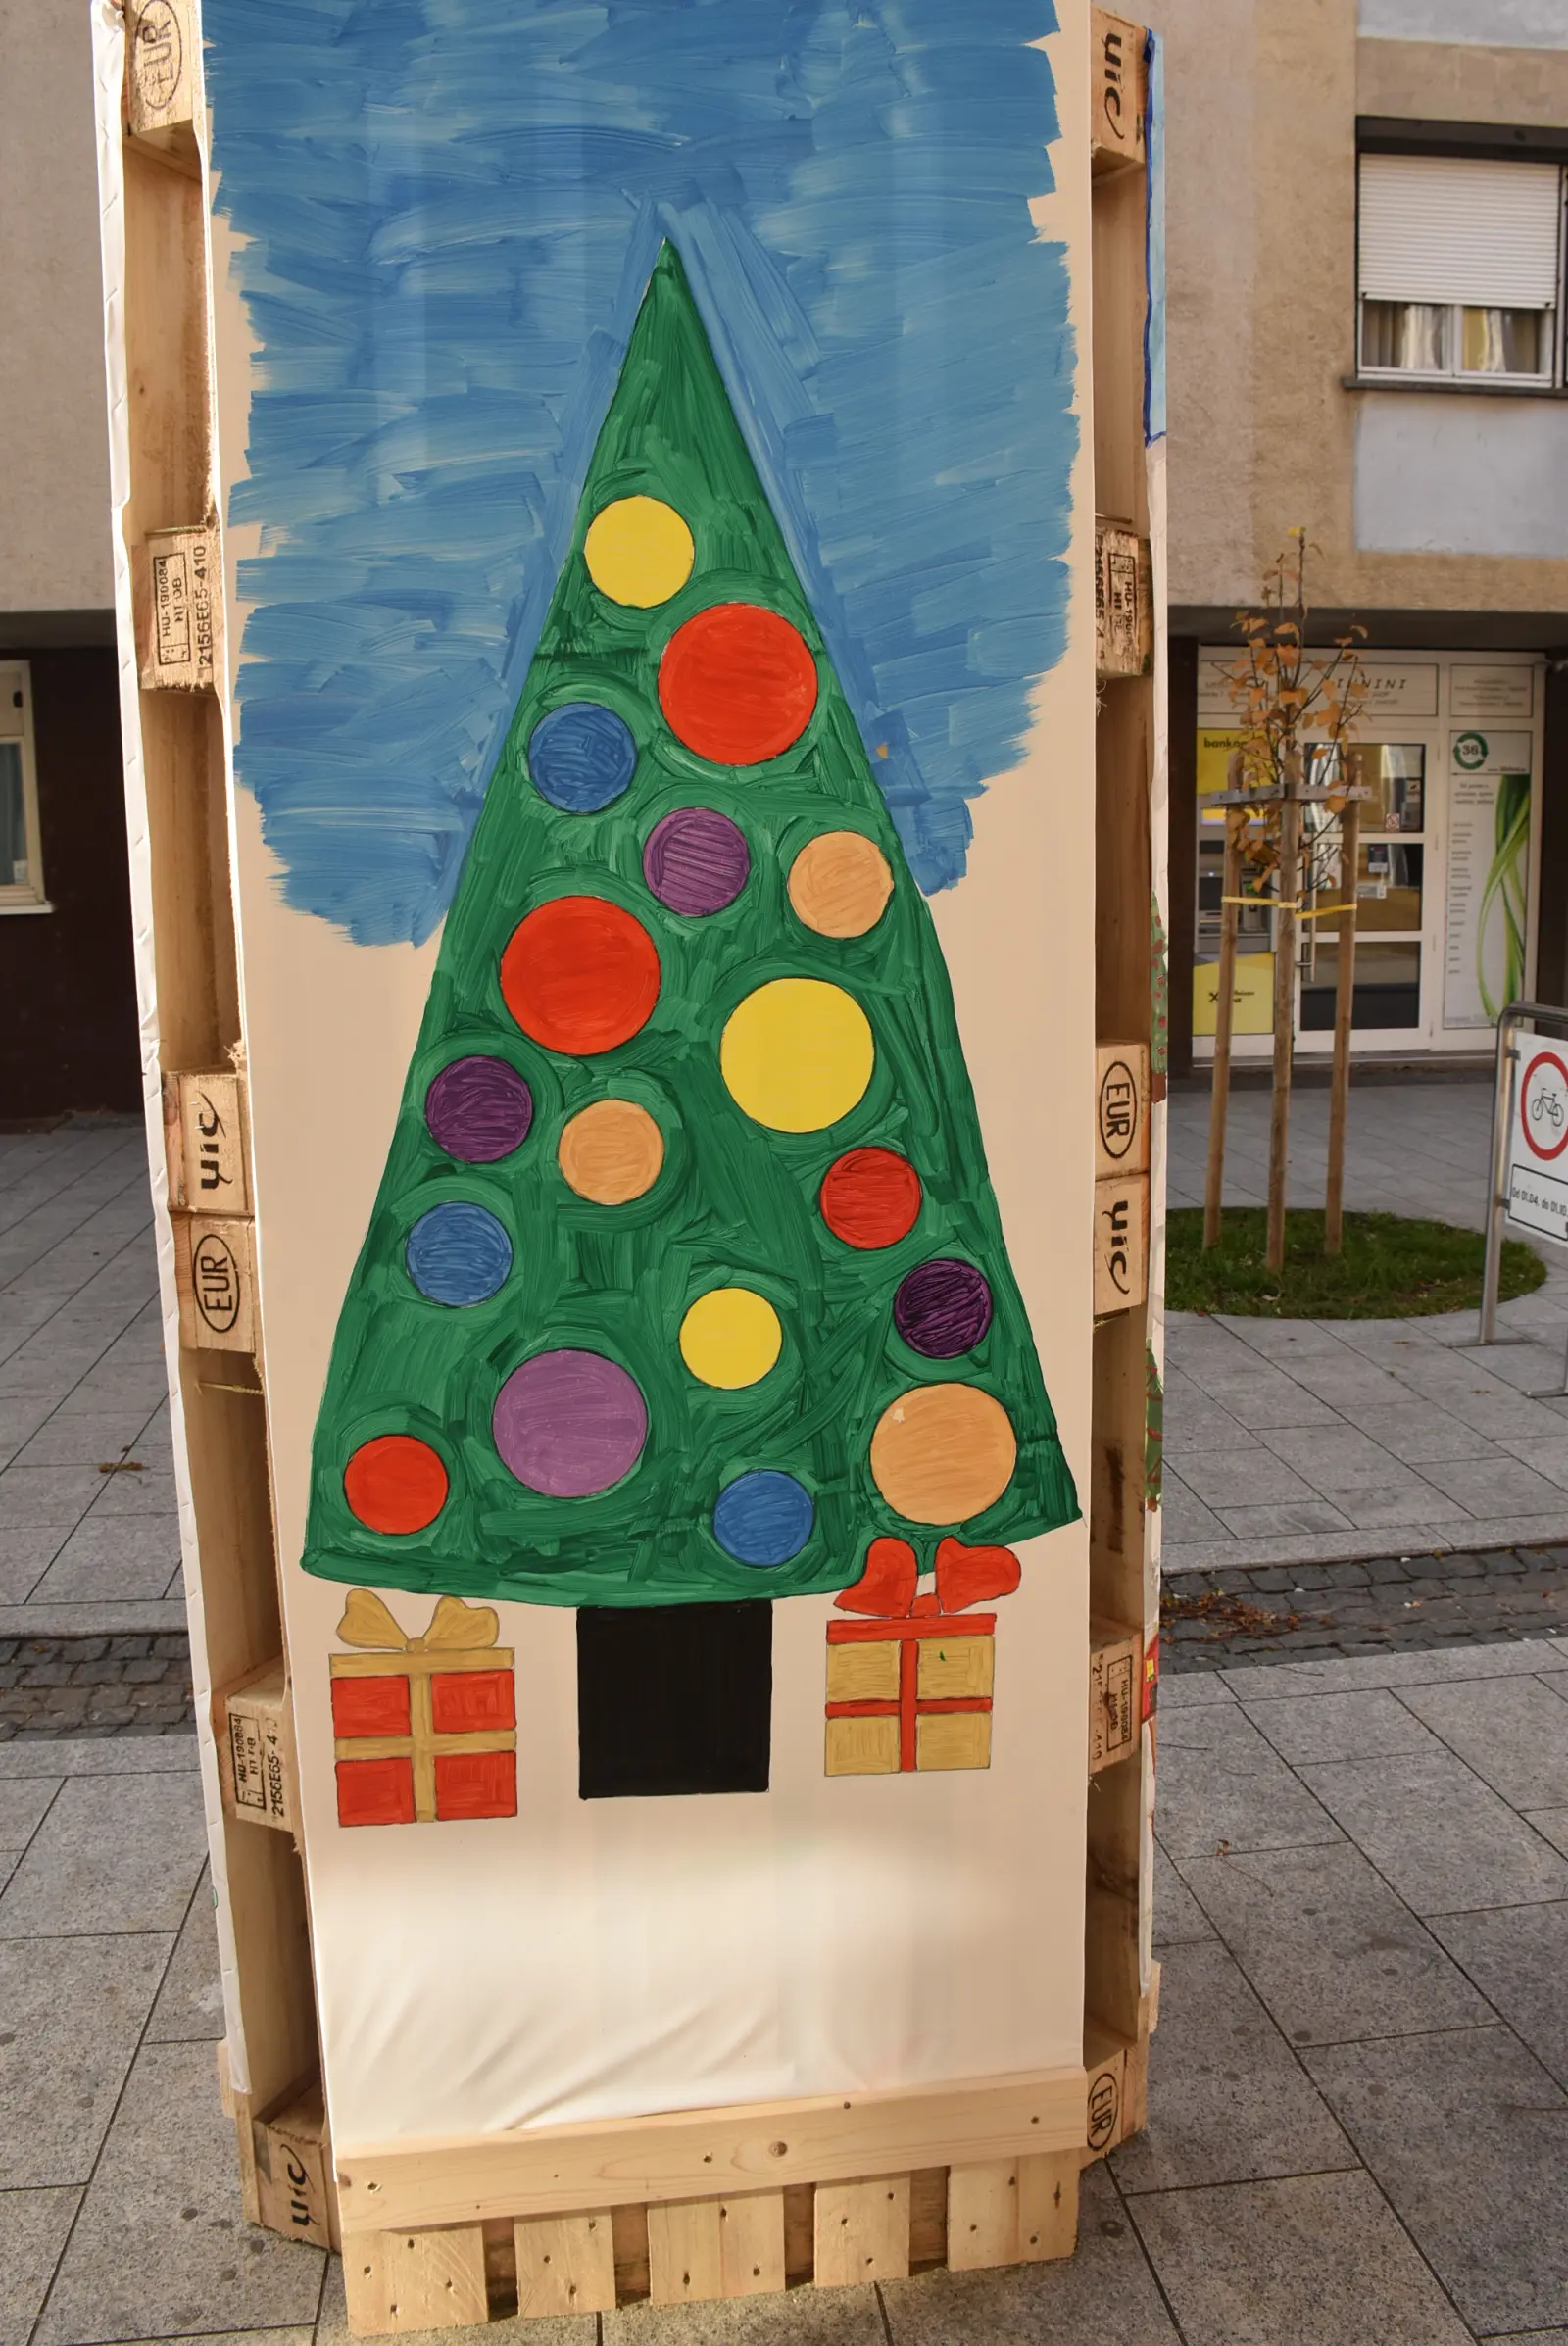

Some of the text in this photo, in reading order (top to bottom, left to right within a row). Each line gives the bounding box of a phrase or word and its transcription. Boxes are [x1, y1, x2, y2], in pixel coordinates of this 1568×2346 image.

[142, 20, 173, 84] EUR
[158, 560, 171, 638] HU-190084
[1106, 1082, 1131, 1139] EUR
[200, 1255, 233, 1312] EUR
[1091, 2084, 1113, 2138] EUR
